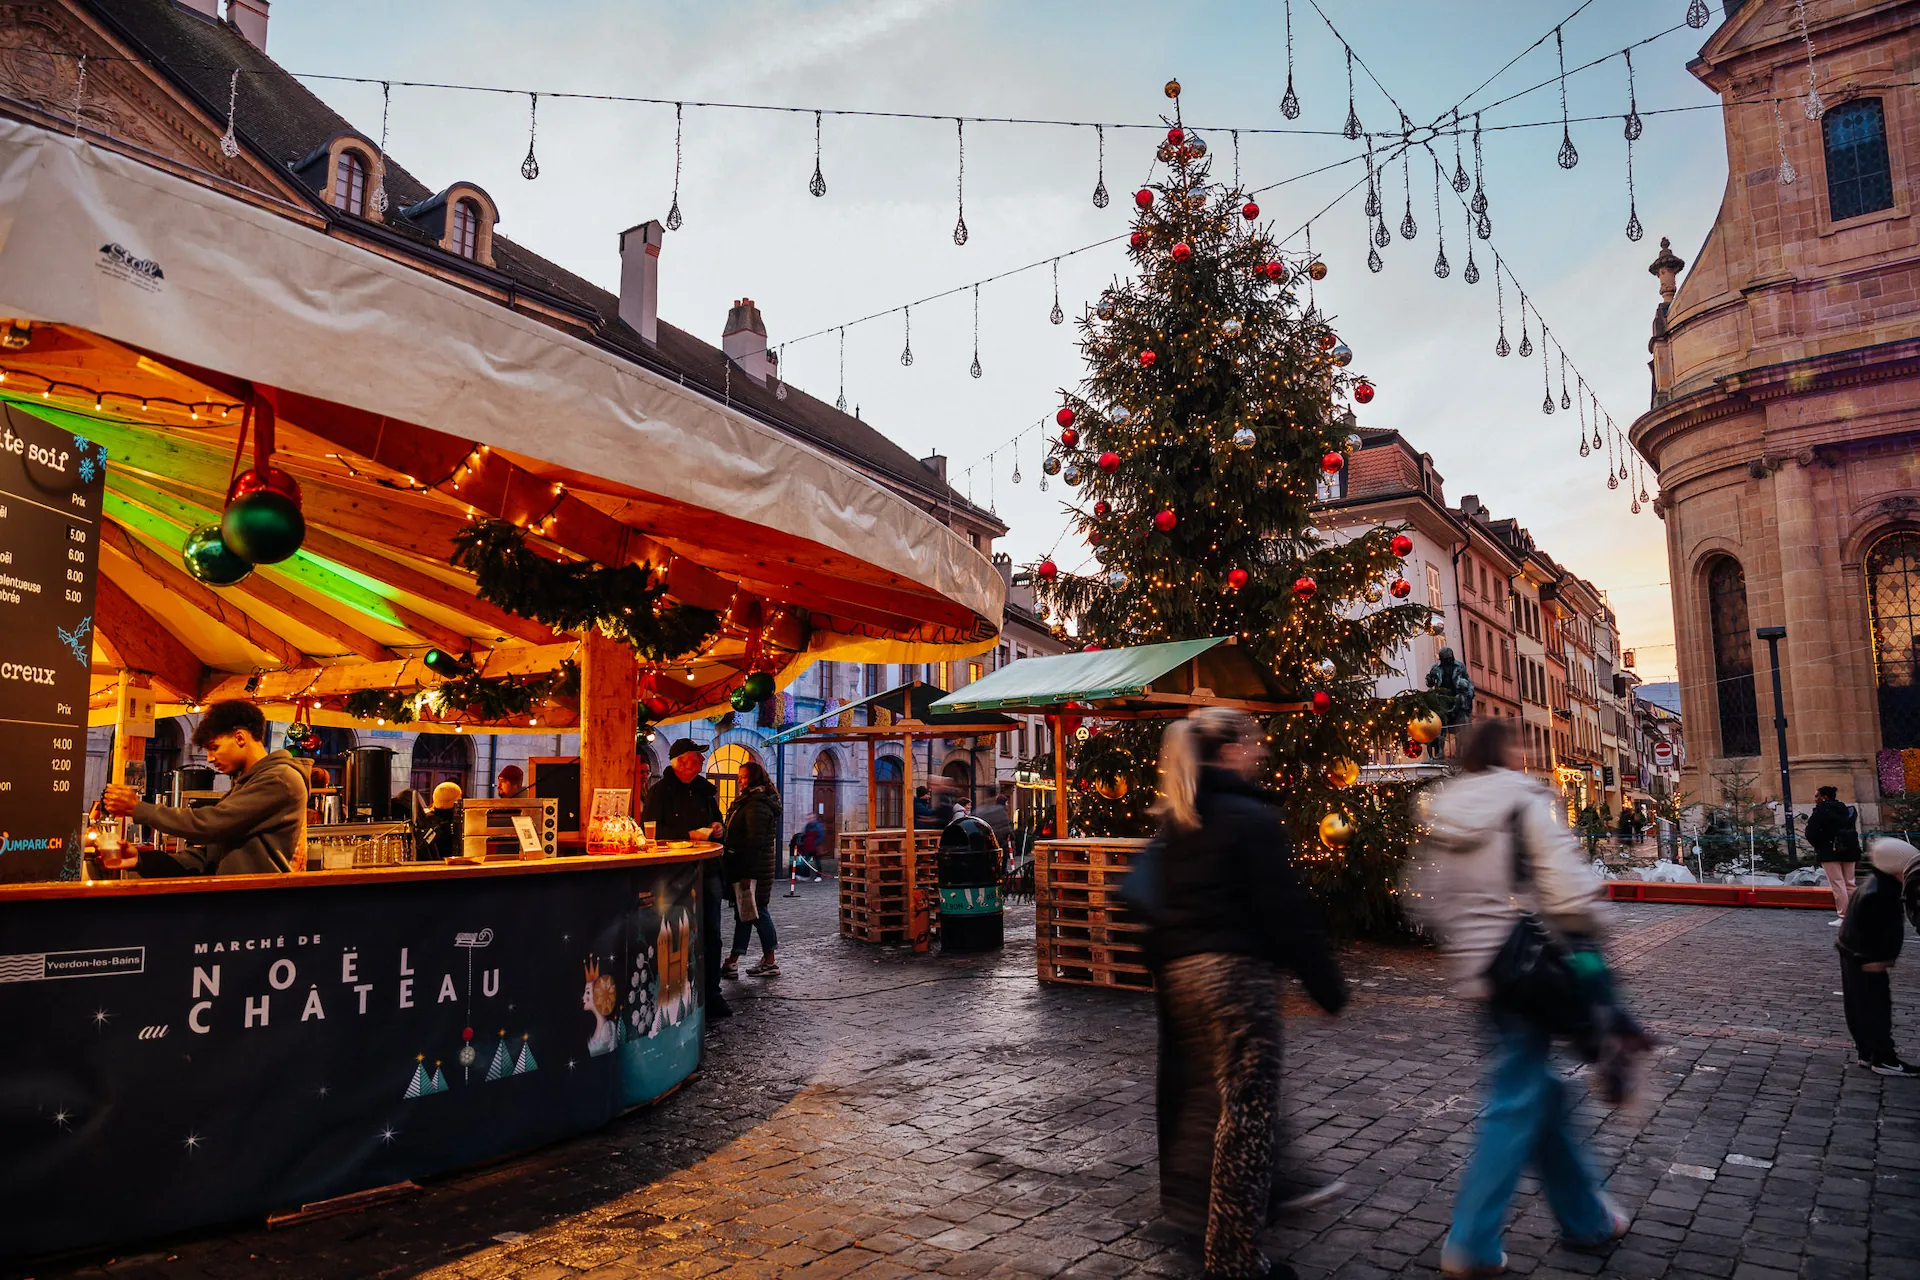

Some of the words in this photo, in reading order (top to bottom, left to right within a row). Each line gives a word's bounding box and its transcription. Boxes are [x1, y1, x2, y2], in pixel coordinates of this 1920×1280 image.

[106, 242, 160, 279] Stoll
[28, 443, 69, 472] soif
[71, 493, 86, 507] Prix
[70, 528, 86, 543] 5.00
[68, 548, 85, 563] 6.00
[66, 568, 84, 583] 8.00
[65, 589, 82, 603] 5.00
[1, 662, 56, 685] creux
[57, 703, 72, 715] Prix
[52, 738, 73, 750] 14.00
[51, 759, 72, 771] 12.00
[52, 780, 70, 791] 5.00
[194, 935, 285, 954] MARCHÉ
[298, 934, 321, 946] DE
[46, 956, 140, 970] Yverdon-les-Bains
[192, 946, 415, 998] NOËL
[137, 1023, 171, 1040] au
[188, 968, 500, 1034] CHÂTEAU
